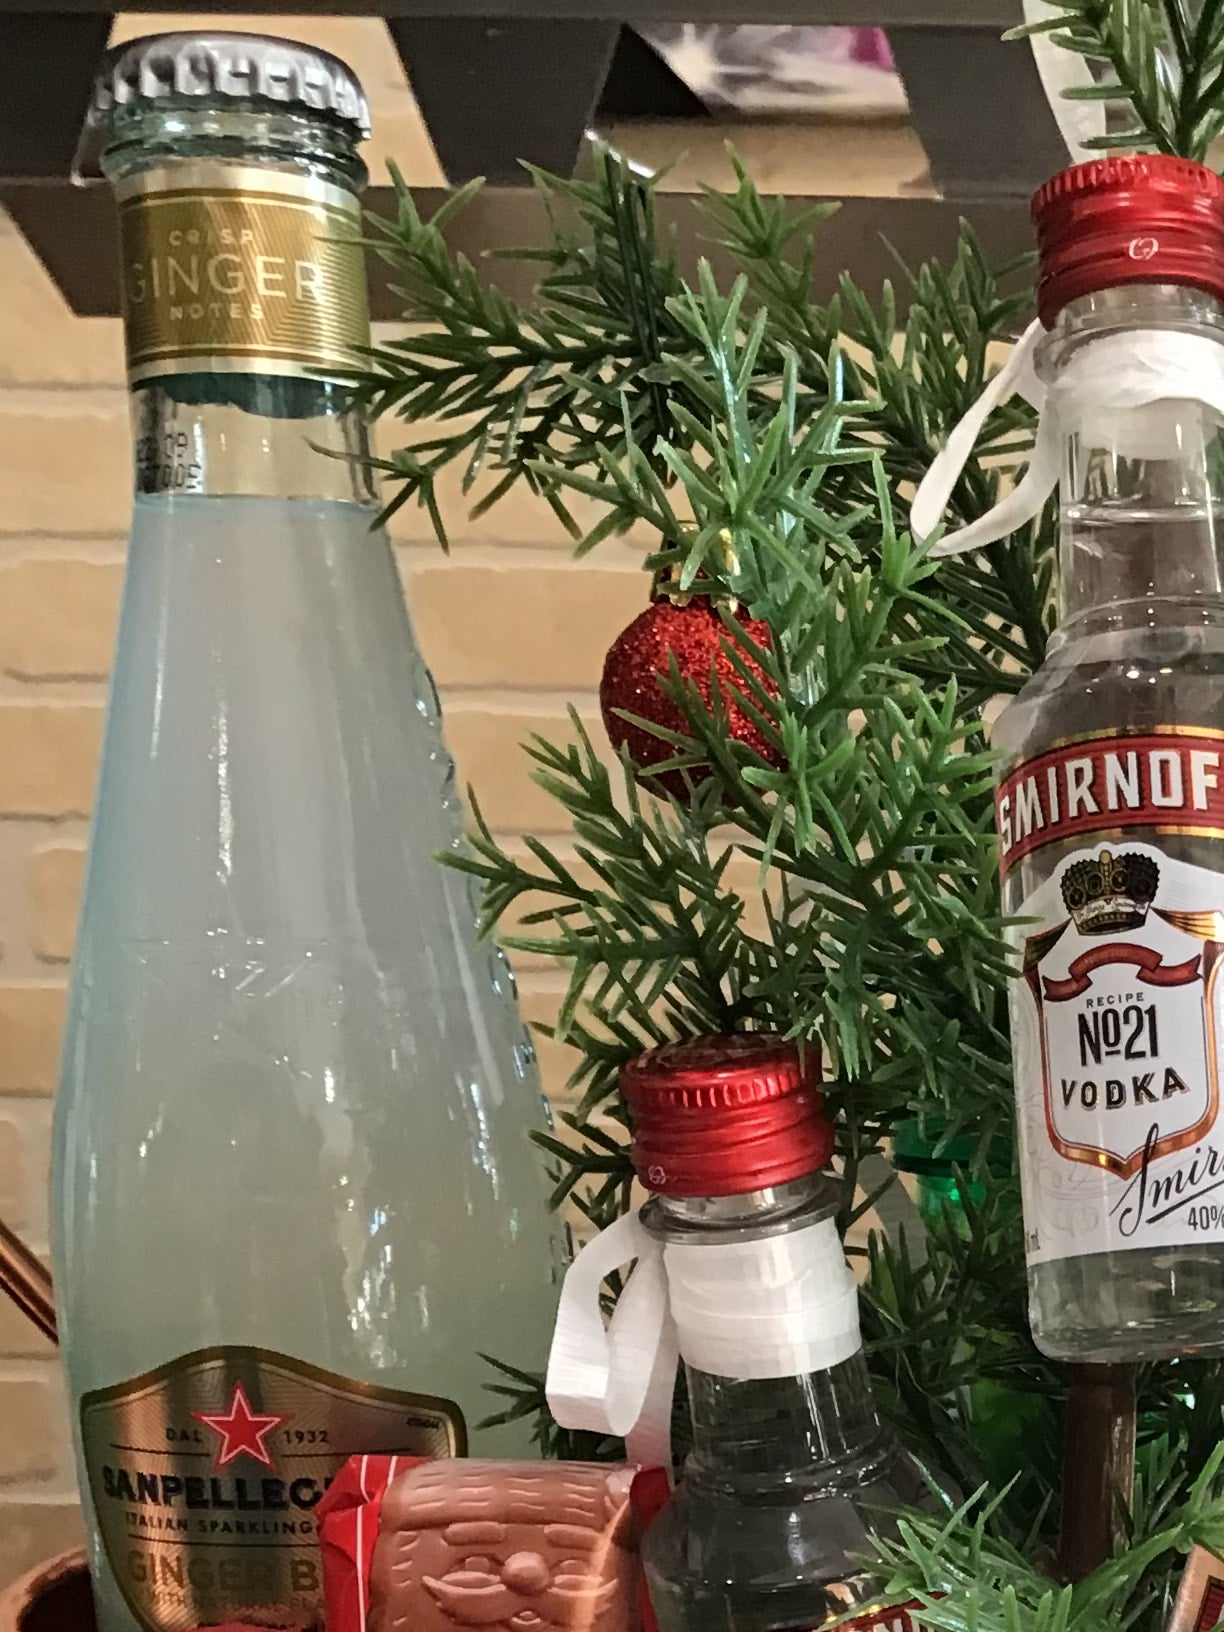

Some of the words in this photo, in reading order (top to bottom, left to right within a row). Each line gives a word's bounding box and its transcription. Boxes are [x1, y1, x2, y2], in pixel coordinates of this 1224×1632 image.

[168, 228, 254, 247] CRISP
[125, 252, 325, 303] GINGER
[169, 303, 264, 321] NOTES
[1086, 991, 1145, 1009] RECIPE
[1061, 1066, 1191, 1111] VODKA
[165, 1427, 202, 1442] DAL
[284, 1430, 329, 1444] 1932
[103, 1466, 337, 1511] SANPELLEG
[125, 1511, 189, 1532] ITALIAN
[199, 1519, 313, 1535] SPARKLING
